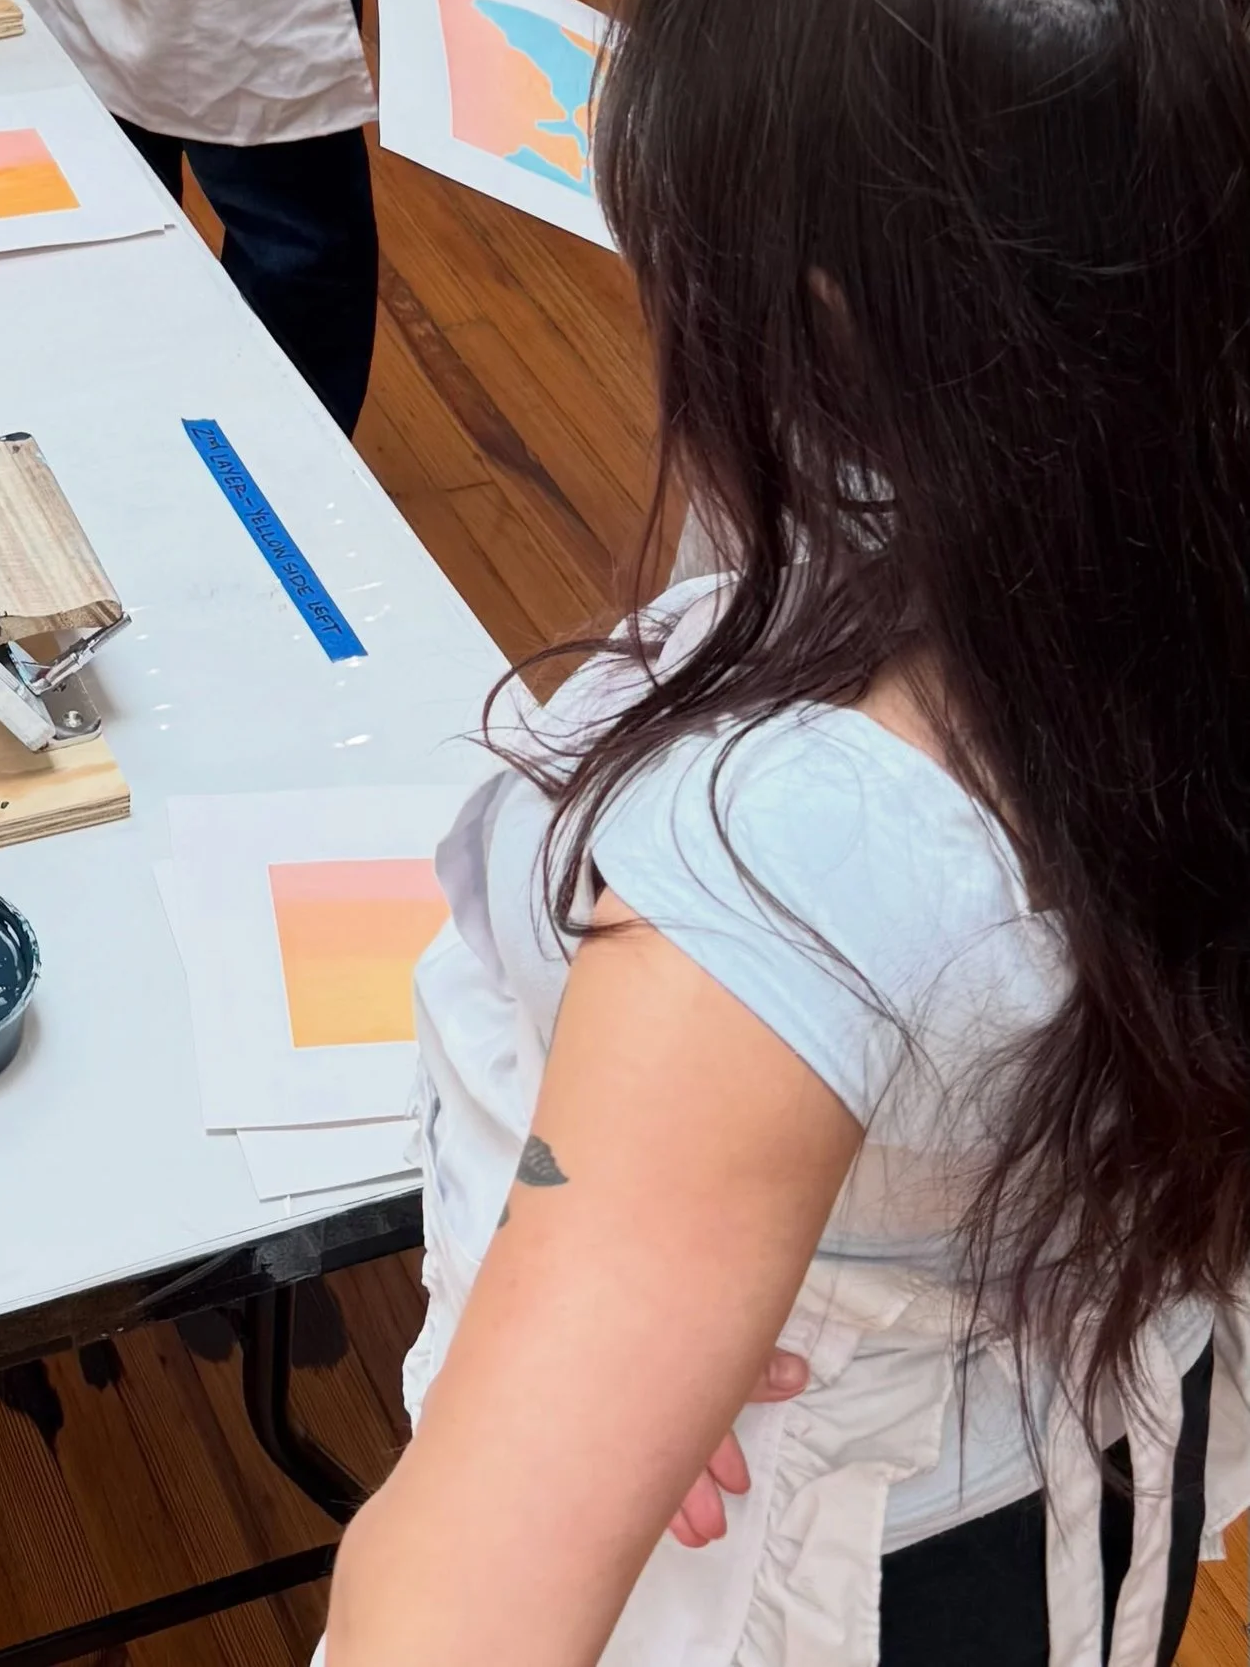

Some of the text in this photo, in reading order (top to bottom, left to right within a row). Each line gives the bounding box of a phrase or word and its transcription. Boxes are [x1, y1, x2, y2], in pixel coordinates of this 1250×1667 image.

[209, 453, 247, 499] LAYER
[245, 508, 295, 560] YELLOW
[283, 562, 315, 596] SIDE
[308, 601, 343, 635] LEFT
